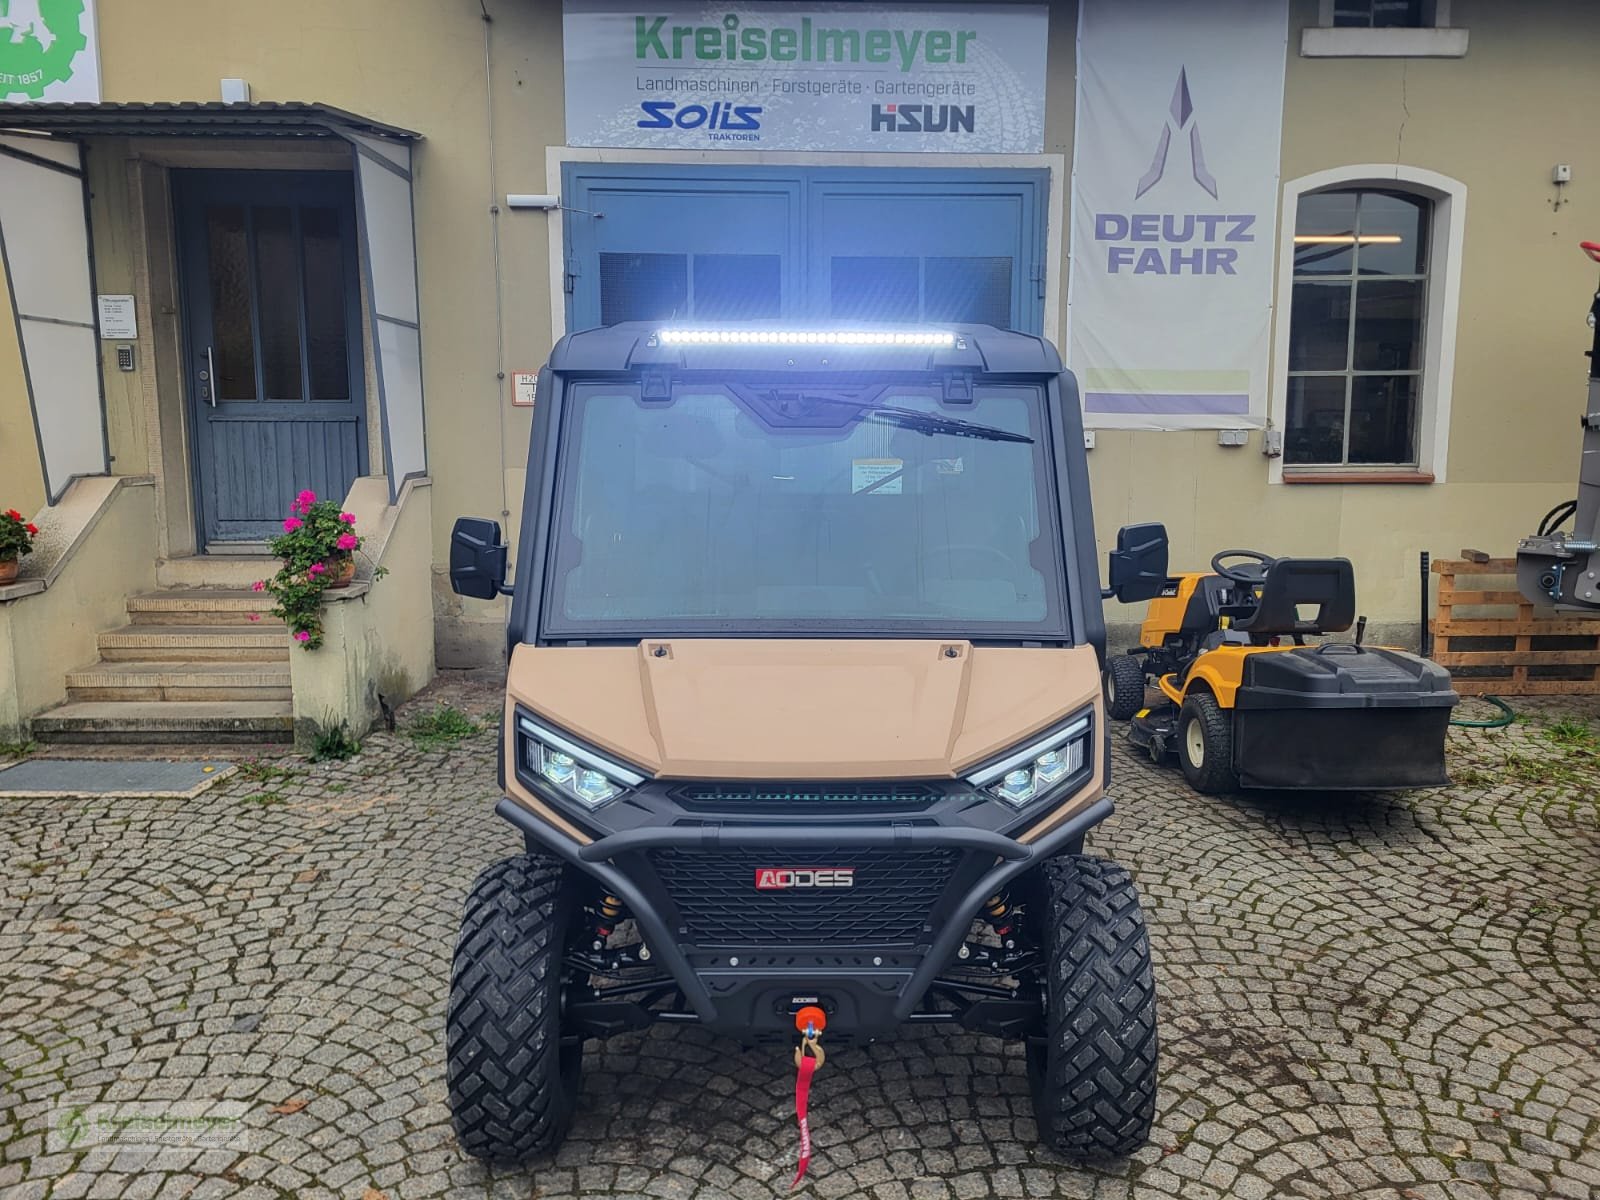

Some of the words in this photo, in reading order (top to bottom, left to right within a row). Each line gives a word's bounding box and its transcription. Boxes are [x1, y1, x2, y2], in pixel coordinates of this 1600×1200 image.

[635, 13, 977, 73] Kreiselmeyer
[18, 69, 43, 85] 1857
[636, 76, 759, 93] Landmaschinen
[772, 78, 862, 96] Forstgeräte
[874, 80, 976, 98] Gartengeräte
[708, 134, 760, 142] TRAKTOREN
[1095, 213, 1256, 242] DEUTZ
[1107, 246, 1239, 275] FAHR
[758, 869, 854, 887] AODES
